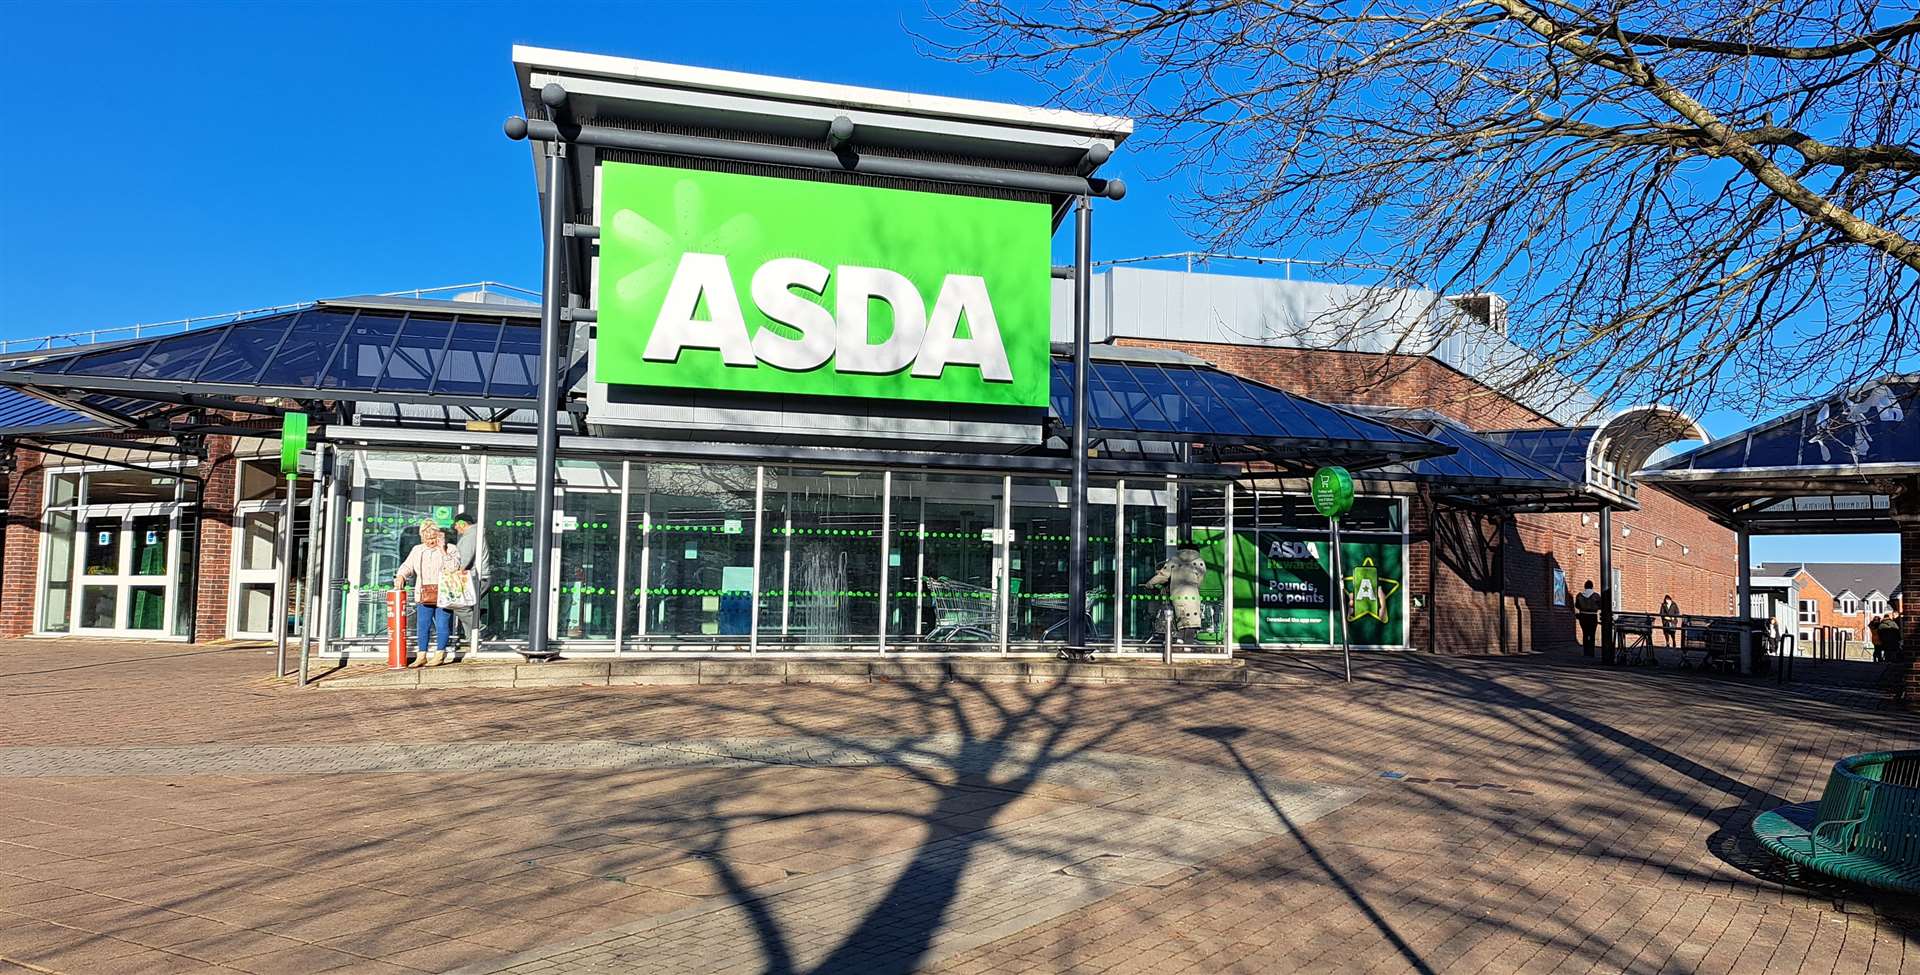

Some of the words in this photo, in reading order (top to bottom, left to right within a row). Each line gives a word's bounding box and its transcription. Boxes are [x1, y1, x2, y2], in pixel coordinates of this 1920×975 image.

[642, 251, 1014, 384] ASDA
[1268, 541, 1320, 558] ASDA
[1269, 580, 1318, 593] Pounds,
[1263, 593, 1283, 602] not
[1286, 592, 1325, 604] points
